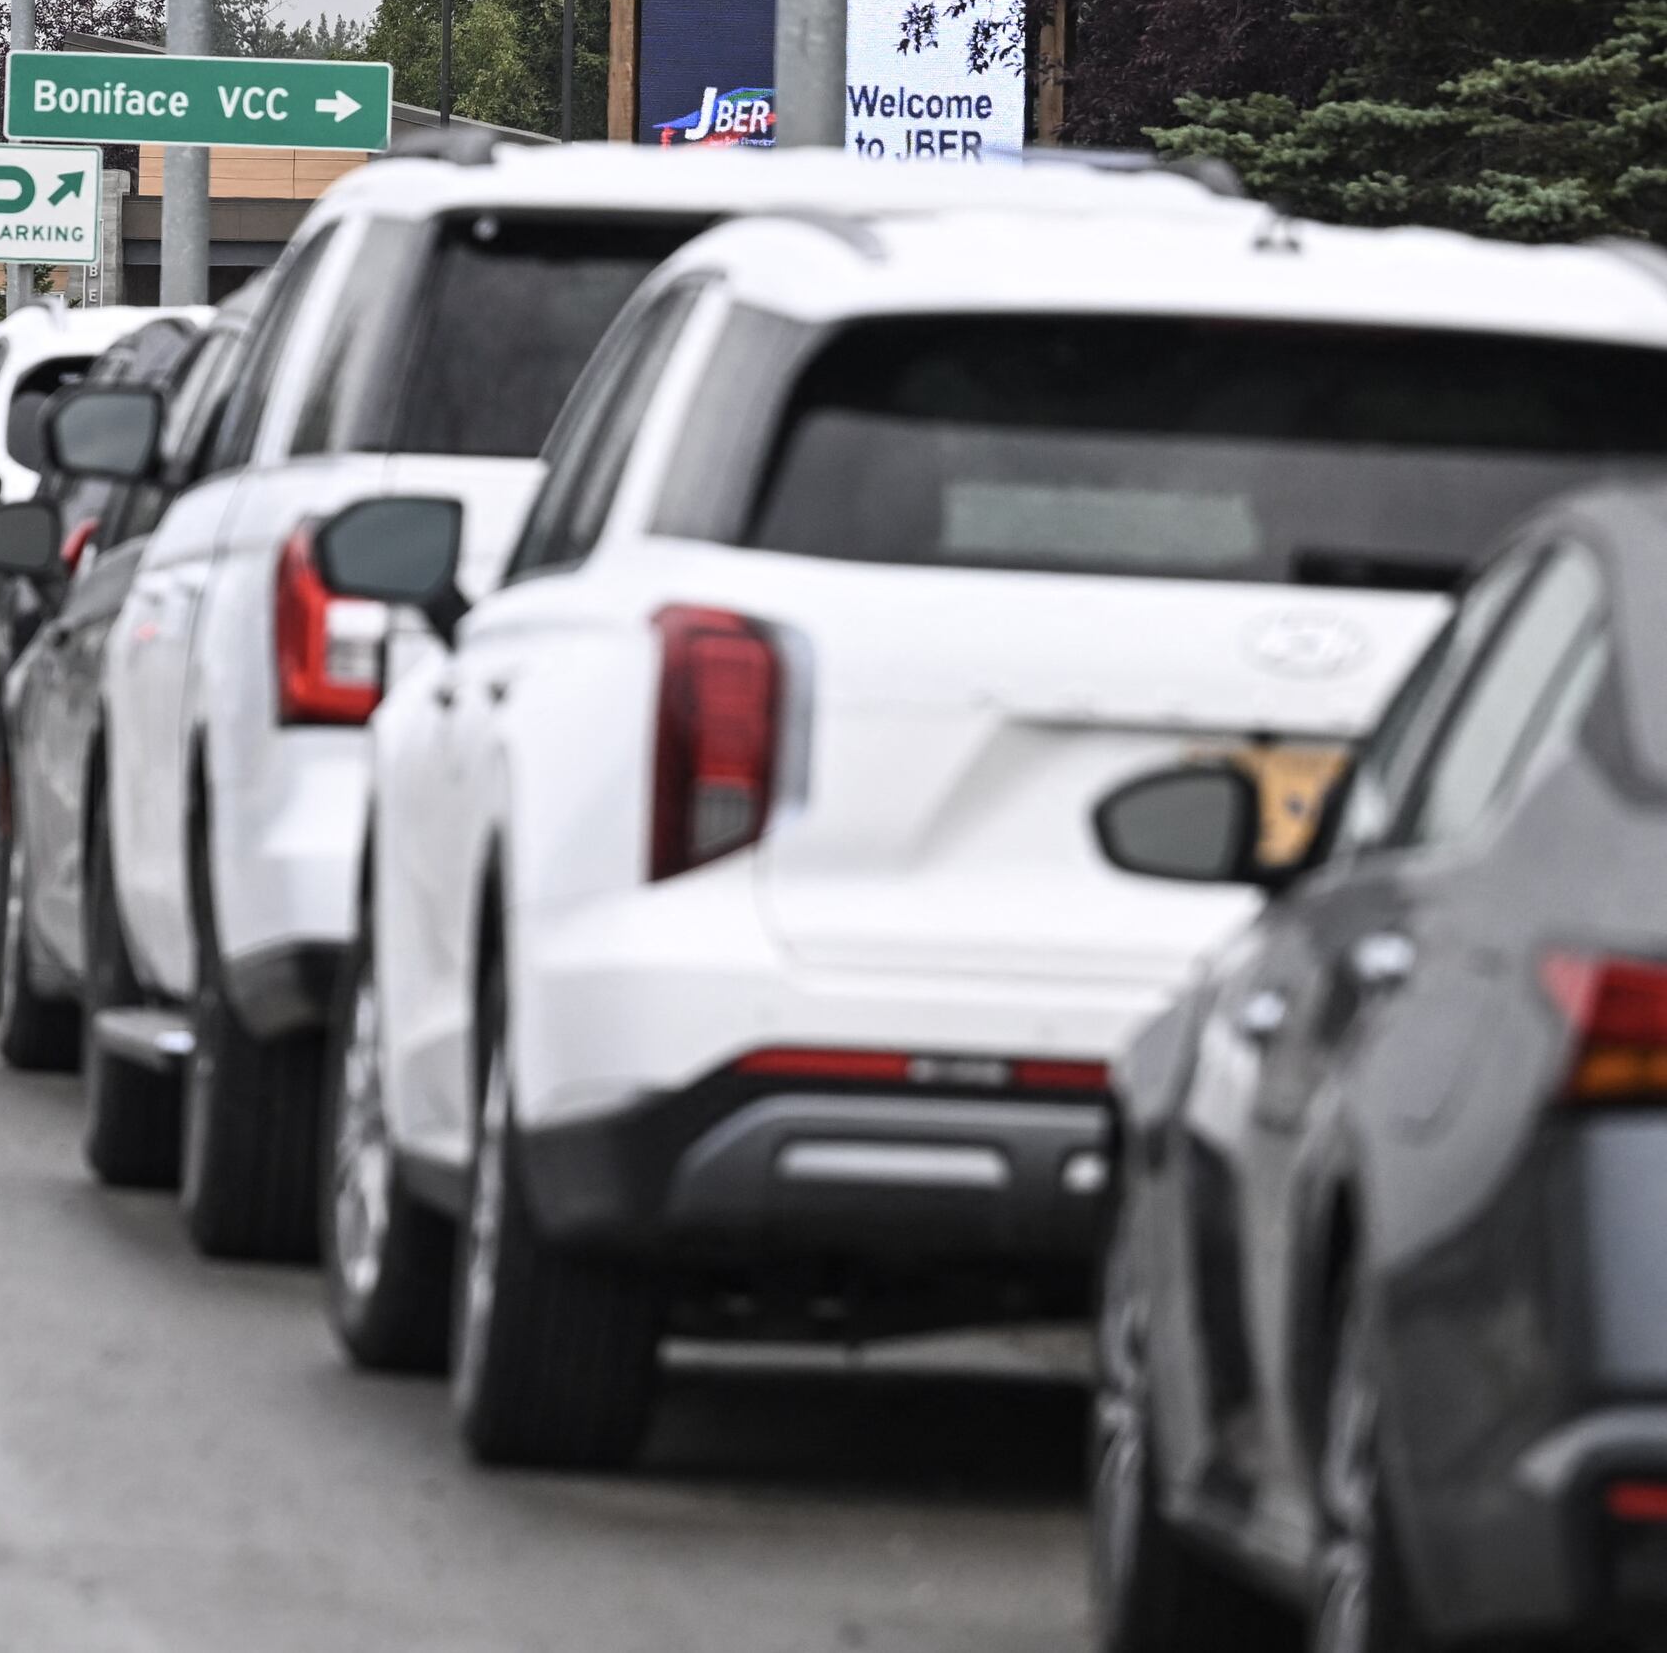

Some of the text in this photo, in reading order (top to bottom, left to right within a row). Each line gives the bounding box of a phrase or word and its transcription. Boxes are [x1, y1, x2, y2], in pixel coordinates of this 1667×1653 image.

[33, 79, 289, 121] Boniface VCC
[684, 87, 770, 141] JBER
[847, 85, 992, 119] Welcome
[855, 129, 983, 162] to JBER
